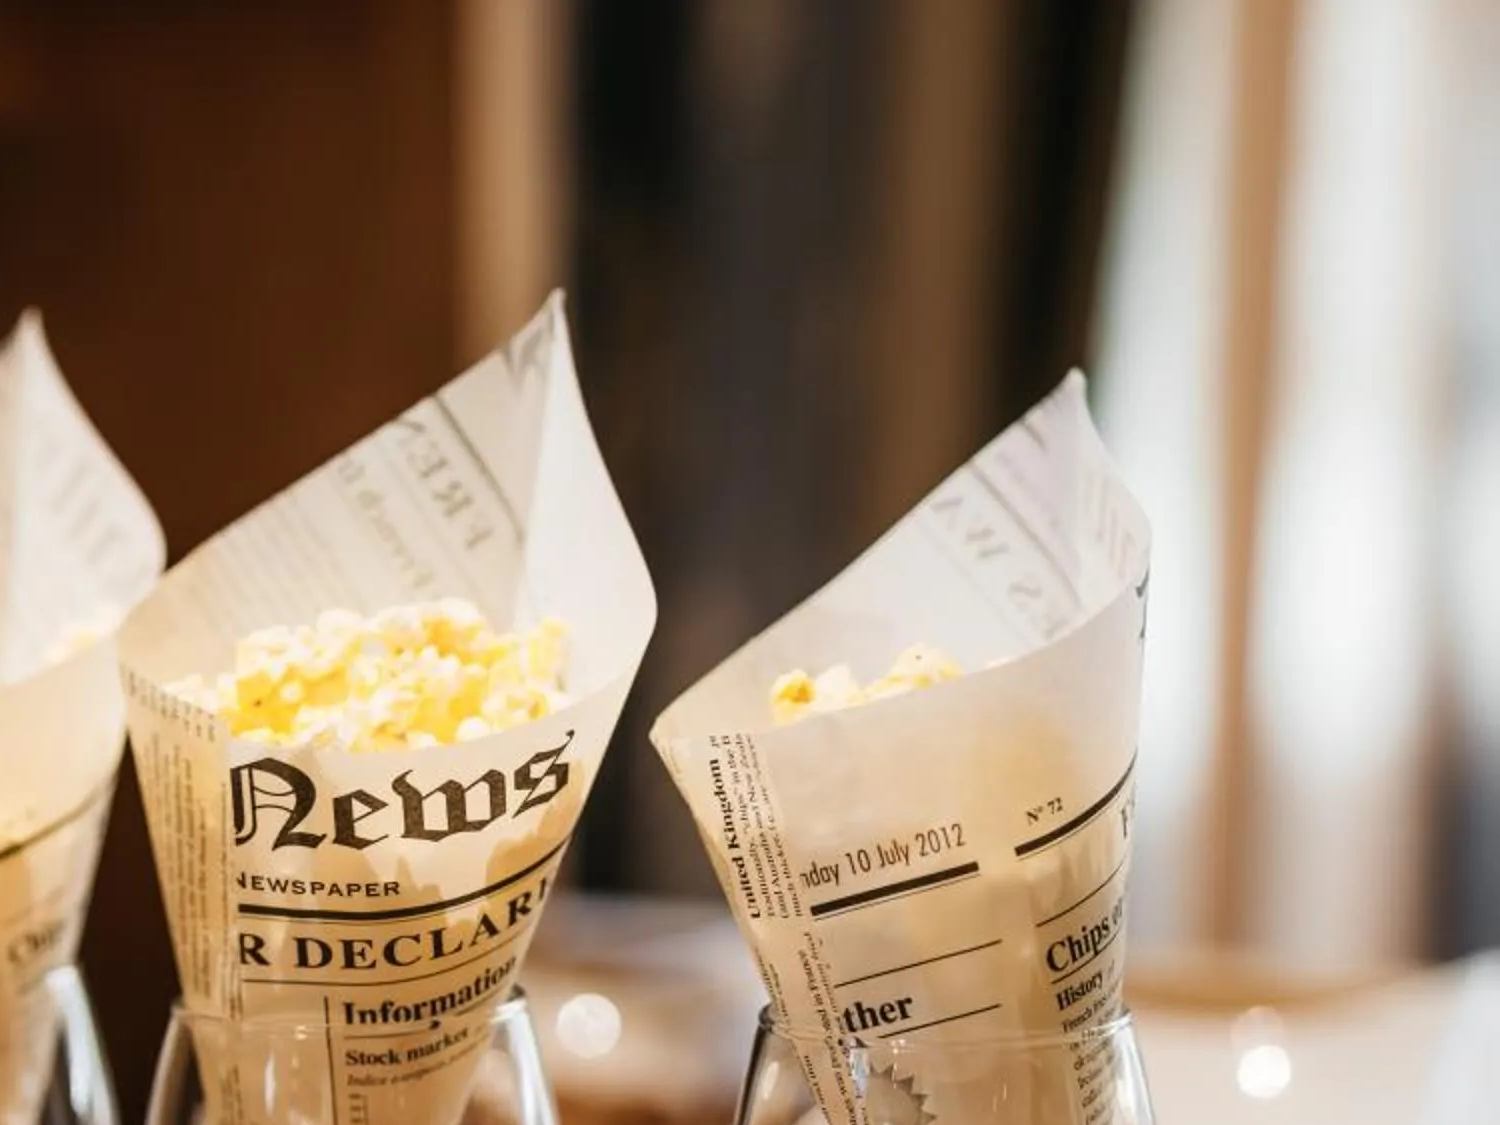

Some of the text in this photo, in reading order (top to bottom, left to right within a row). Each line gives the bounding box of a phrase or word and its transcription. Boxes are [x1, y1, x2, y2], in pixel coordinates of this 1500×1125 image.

[229, 728, 576, 852] News
[708, 758, 761, 919] United Kingdom
[844, 848, 872, 877] 10
[877, 837, 910, 869] July
[915, 822, 966, 858] 2012
[1045, 916, 1111, 973] Chips
[342, 956, 518, 1025] Information
[842, 996, 914, 1034] ther
[345, 1049, 403, 1067] Stock
